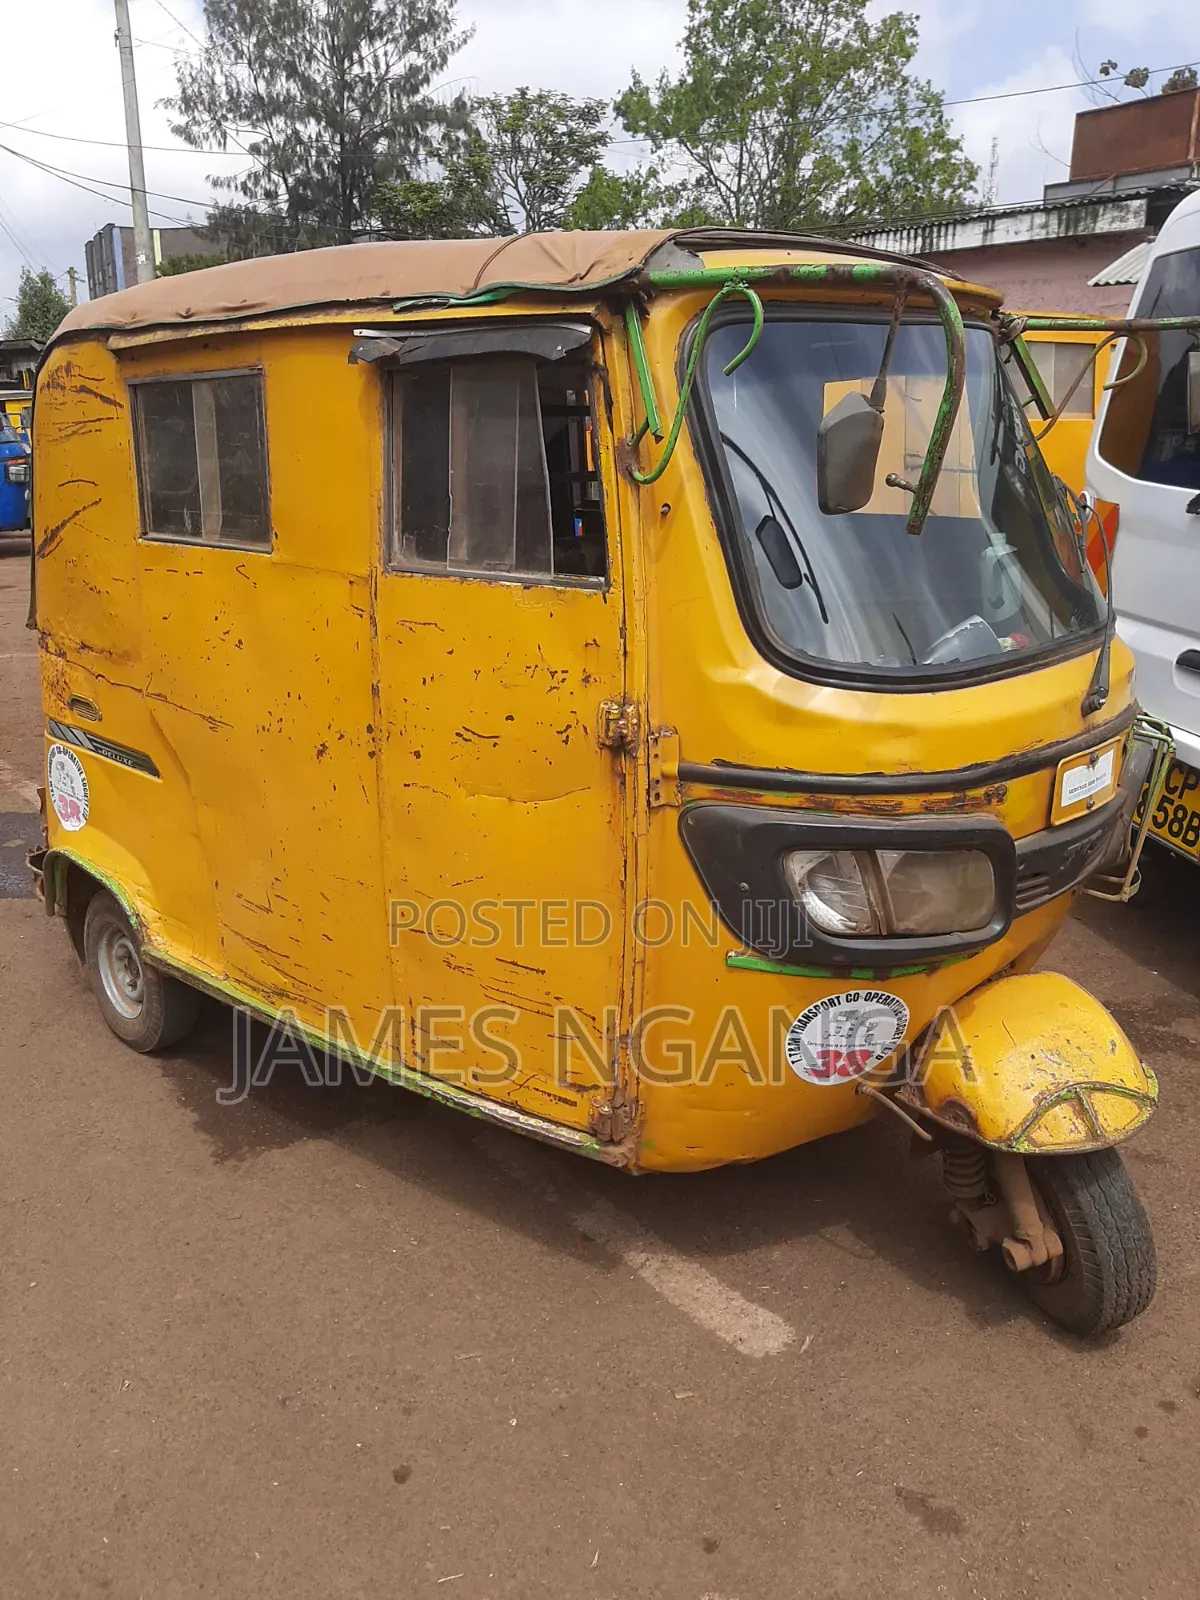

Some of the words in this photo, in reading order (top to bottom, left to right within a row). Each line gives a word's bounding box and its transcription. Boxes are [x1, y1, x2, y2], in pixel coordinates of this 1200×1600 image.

[102, 749, 134, 767] DELUXE
[1068, 782, 1088, 795] SERVICE
[790, 995, 842, 1036] TRANSPORT
[845, 991, 907, 1017] CO-OPERATIVE
[890, 1013, 908, 1046] SOCIETY
